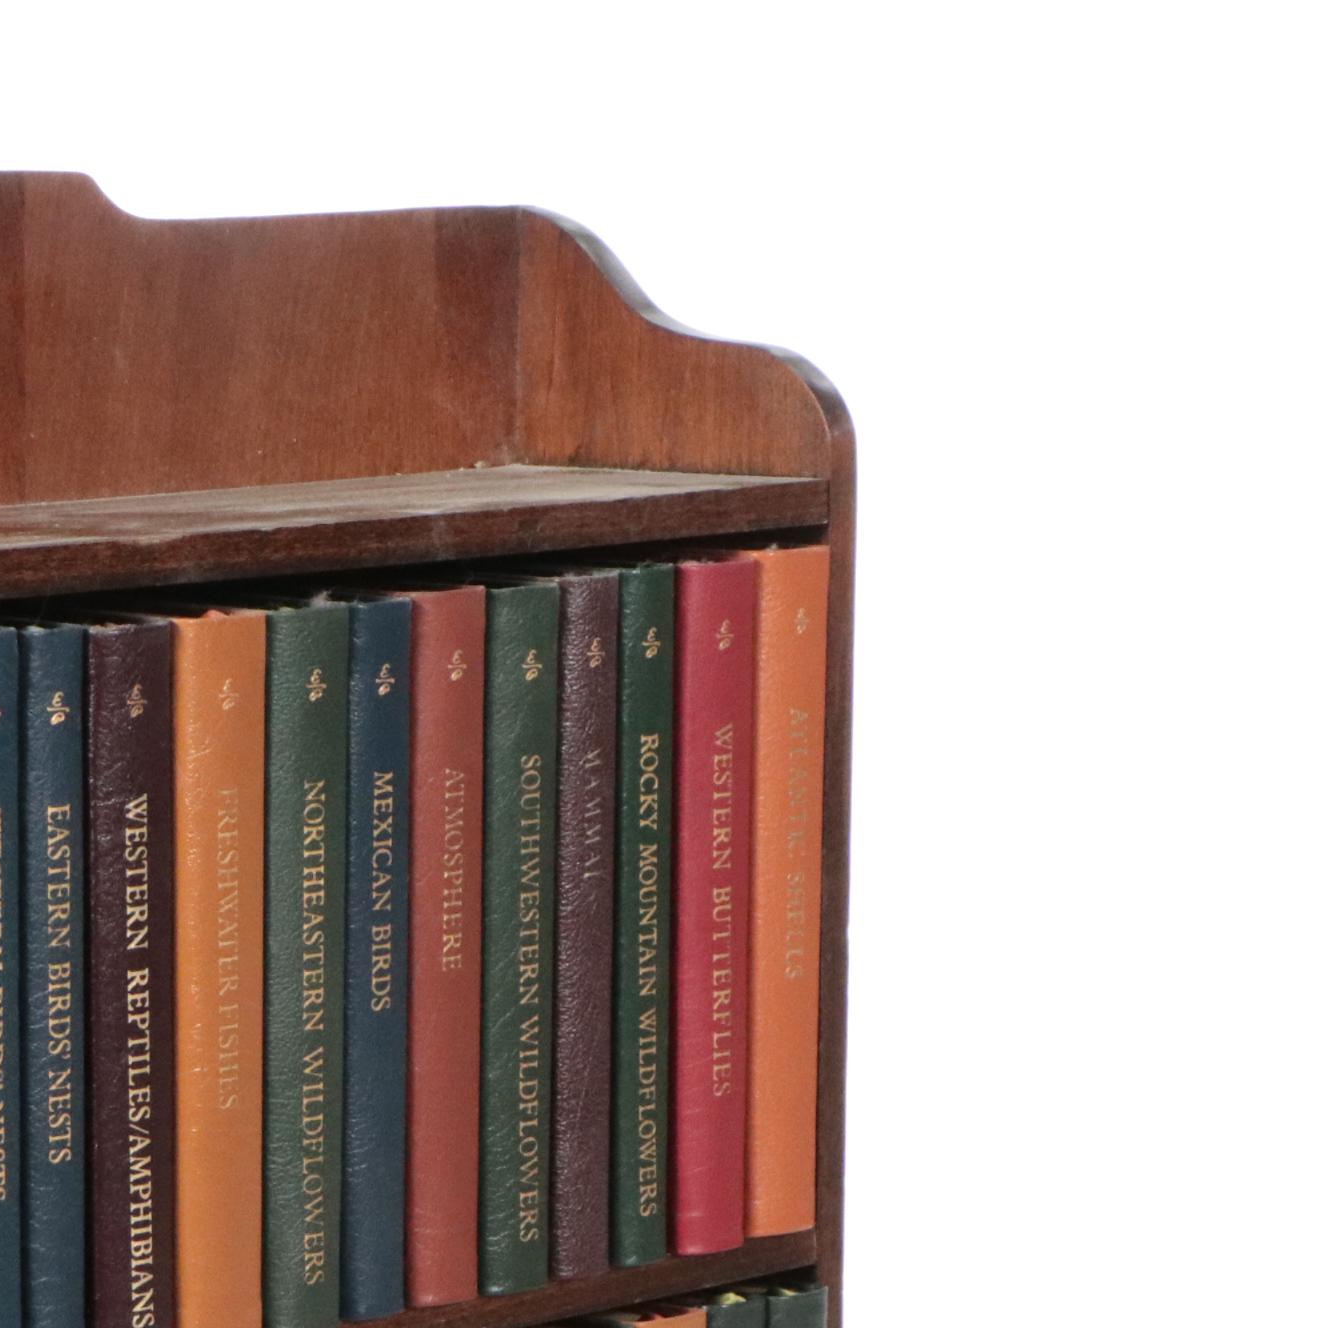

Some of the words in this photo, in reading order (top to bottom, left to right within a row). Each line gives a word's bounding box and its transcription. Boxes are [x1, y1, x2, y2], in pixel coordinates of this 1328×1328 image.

[123, 793, 148, 949] WESTERN
[373, 770, 394, 912] MEXICAN
[443, 768, 464, 972] ATMOSPHERE
[640, 733, 658, 831] ROCKY
[712, 723, 733, 874] WESTERN
[46, 803, 69, 949] EASTERN
[217, 788, 240, 996] FRESHWATER
[304, 779, 326, 1032] NORTHEASTERN
[520, 754, 541, 1005] SOUTHWESTERN
[639, 839, 657, 997] MOUNTAIN
[220, 1004, 240, 1111] FISHES
[371, 923, 392, 1012] BIRDS
[711, 887, 733, 1098] BUTTERFLIES
[49, 1068, 72, 1165] NESTS
[127, 968, 155, 1328] REPTILES/AMPHIBIANS
[303, 1046, 324, 1286] WILDFLOWERS
[519, 1014, 540, 1243] WILDFLOWERS
[638, 1006, 656, 1217] WILDFLOWERS
